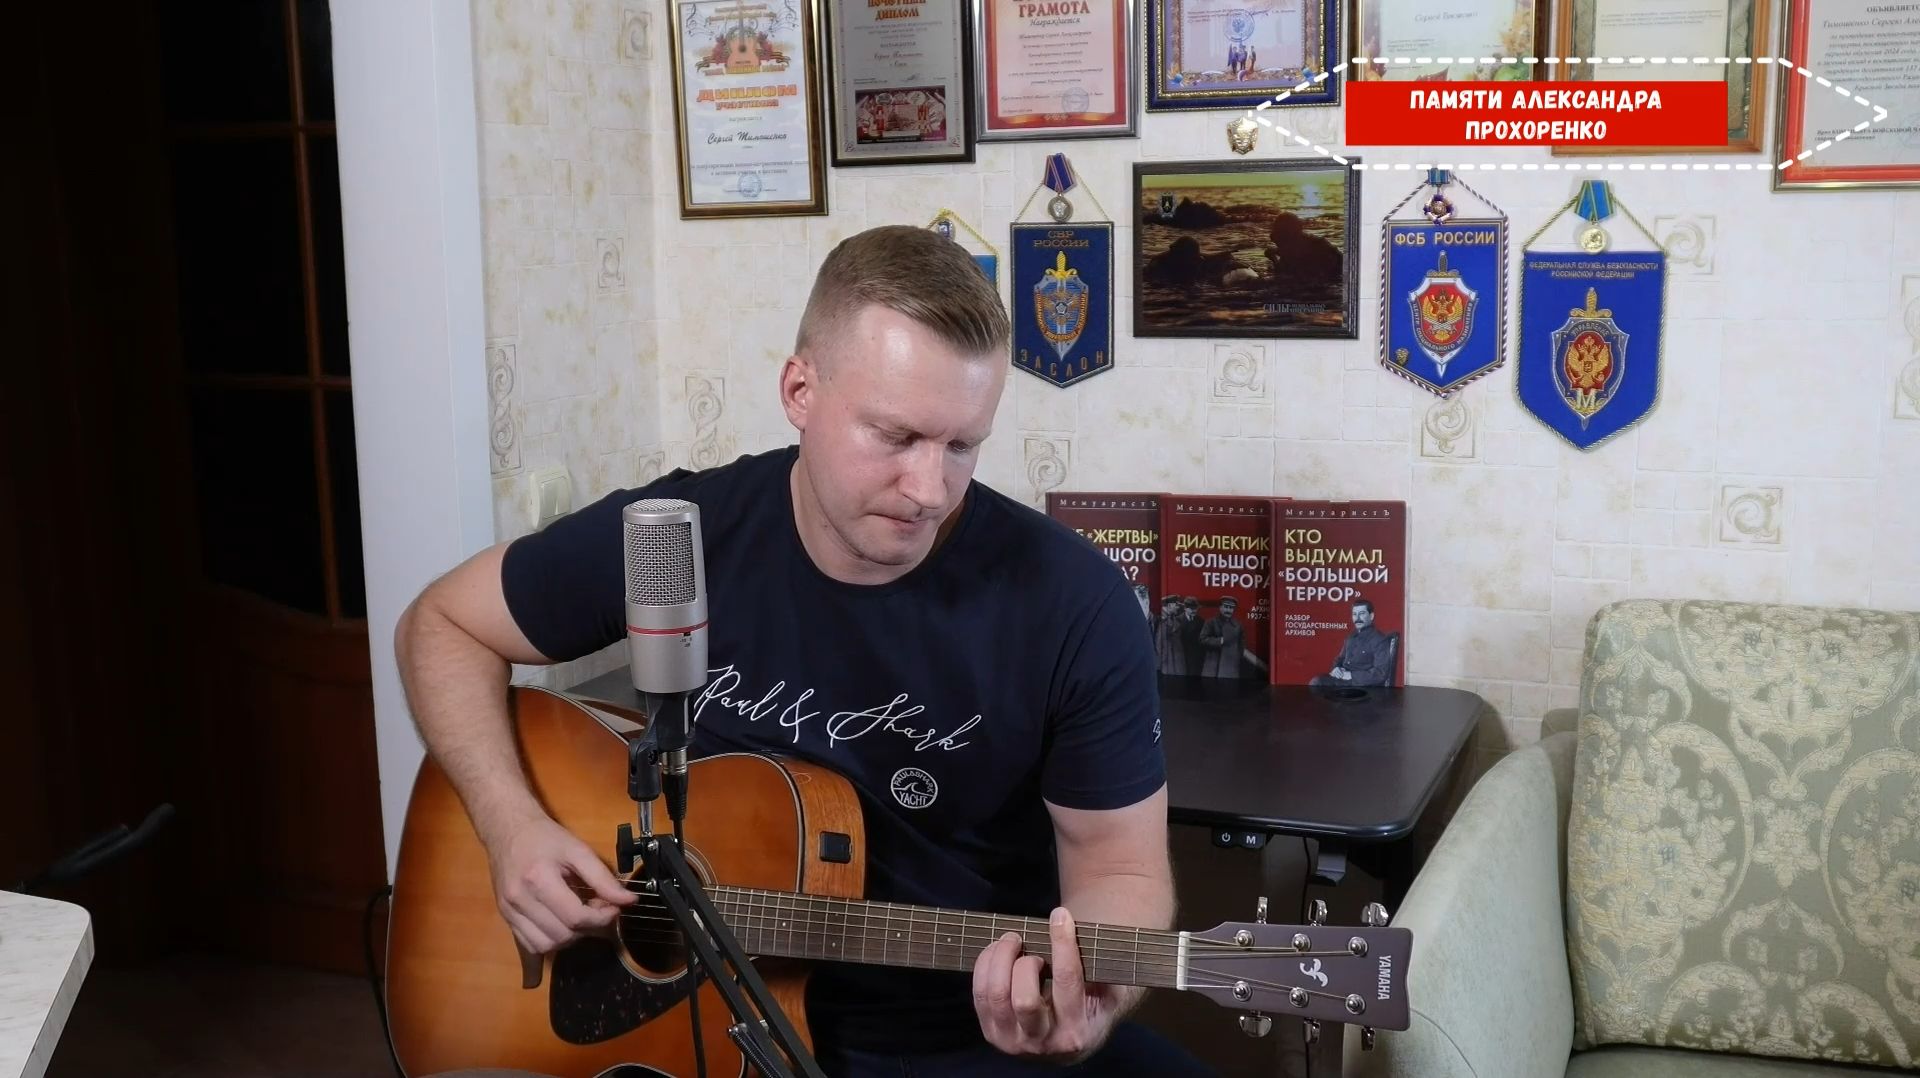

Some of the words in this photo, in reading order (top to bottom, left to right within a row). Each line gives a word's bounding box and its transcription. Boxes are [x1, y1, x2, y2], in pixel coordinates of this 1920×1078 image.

[875, 8, 919, 21] ДИПЛОМ
[1018, 1, 1091, 18] ГРАМОТА
[696, 84, 798, 102] ДИПЛОМ
[707, 132, 734, 145] Сергей
[1047, 230, 1075, 238] СВР
[1394, 232, 1426, 245] ФСБ
[1434, 231, 1495, 245] РОССИИ
[1033, 239, 1089, 247] РОССИИ
[1529, 261, 1577, 269] ФЕДЕРАЛЬНАЯ
[1577, 261, 1605, 269] СЛУЖБА
[1606, 261, 1659, 270] БЕЗОПАСНОСТИ
[1551, 270, 1594, 278] РОССИЙСКОЙ
[1595, 270, 1635, 278] ФЕДЕРАЦИИ
[1176, 503, 1265, 513] Мемуарист
[1087, 529, 1159, 544] «ЖЕРТВЫ»
[1175, 534, 1270, 551] ДИАЛЕКТИК
[1285, 529, 1322, 544] КТО
[1103, 547, 1156, 563] ШОГО
[1285, 548, 1383, 566] ВЫДУМАЛ
[1278, 564, 1389, 584] «БОЛЬШОЙ
[1286, 586, 1361, 602] ТЕРРОР»
[1285, 621, 1348, 630] ГОСУДАРСТВЕННЫХ
[1285, 629, 1316, 637] АРХИВОВ
[693, 663, 786, 722] Paul
[779, 688, 821, 744] &
[826, 693, 982, 752] Shark
[899, 791, 929, 806] YACHT
[1246, 835, 1256, 845] M
[1377, 955, 1392, 1000] YAMAHA
